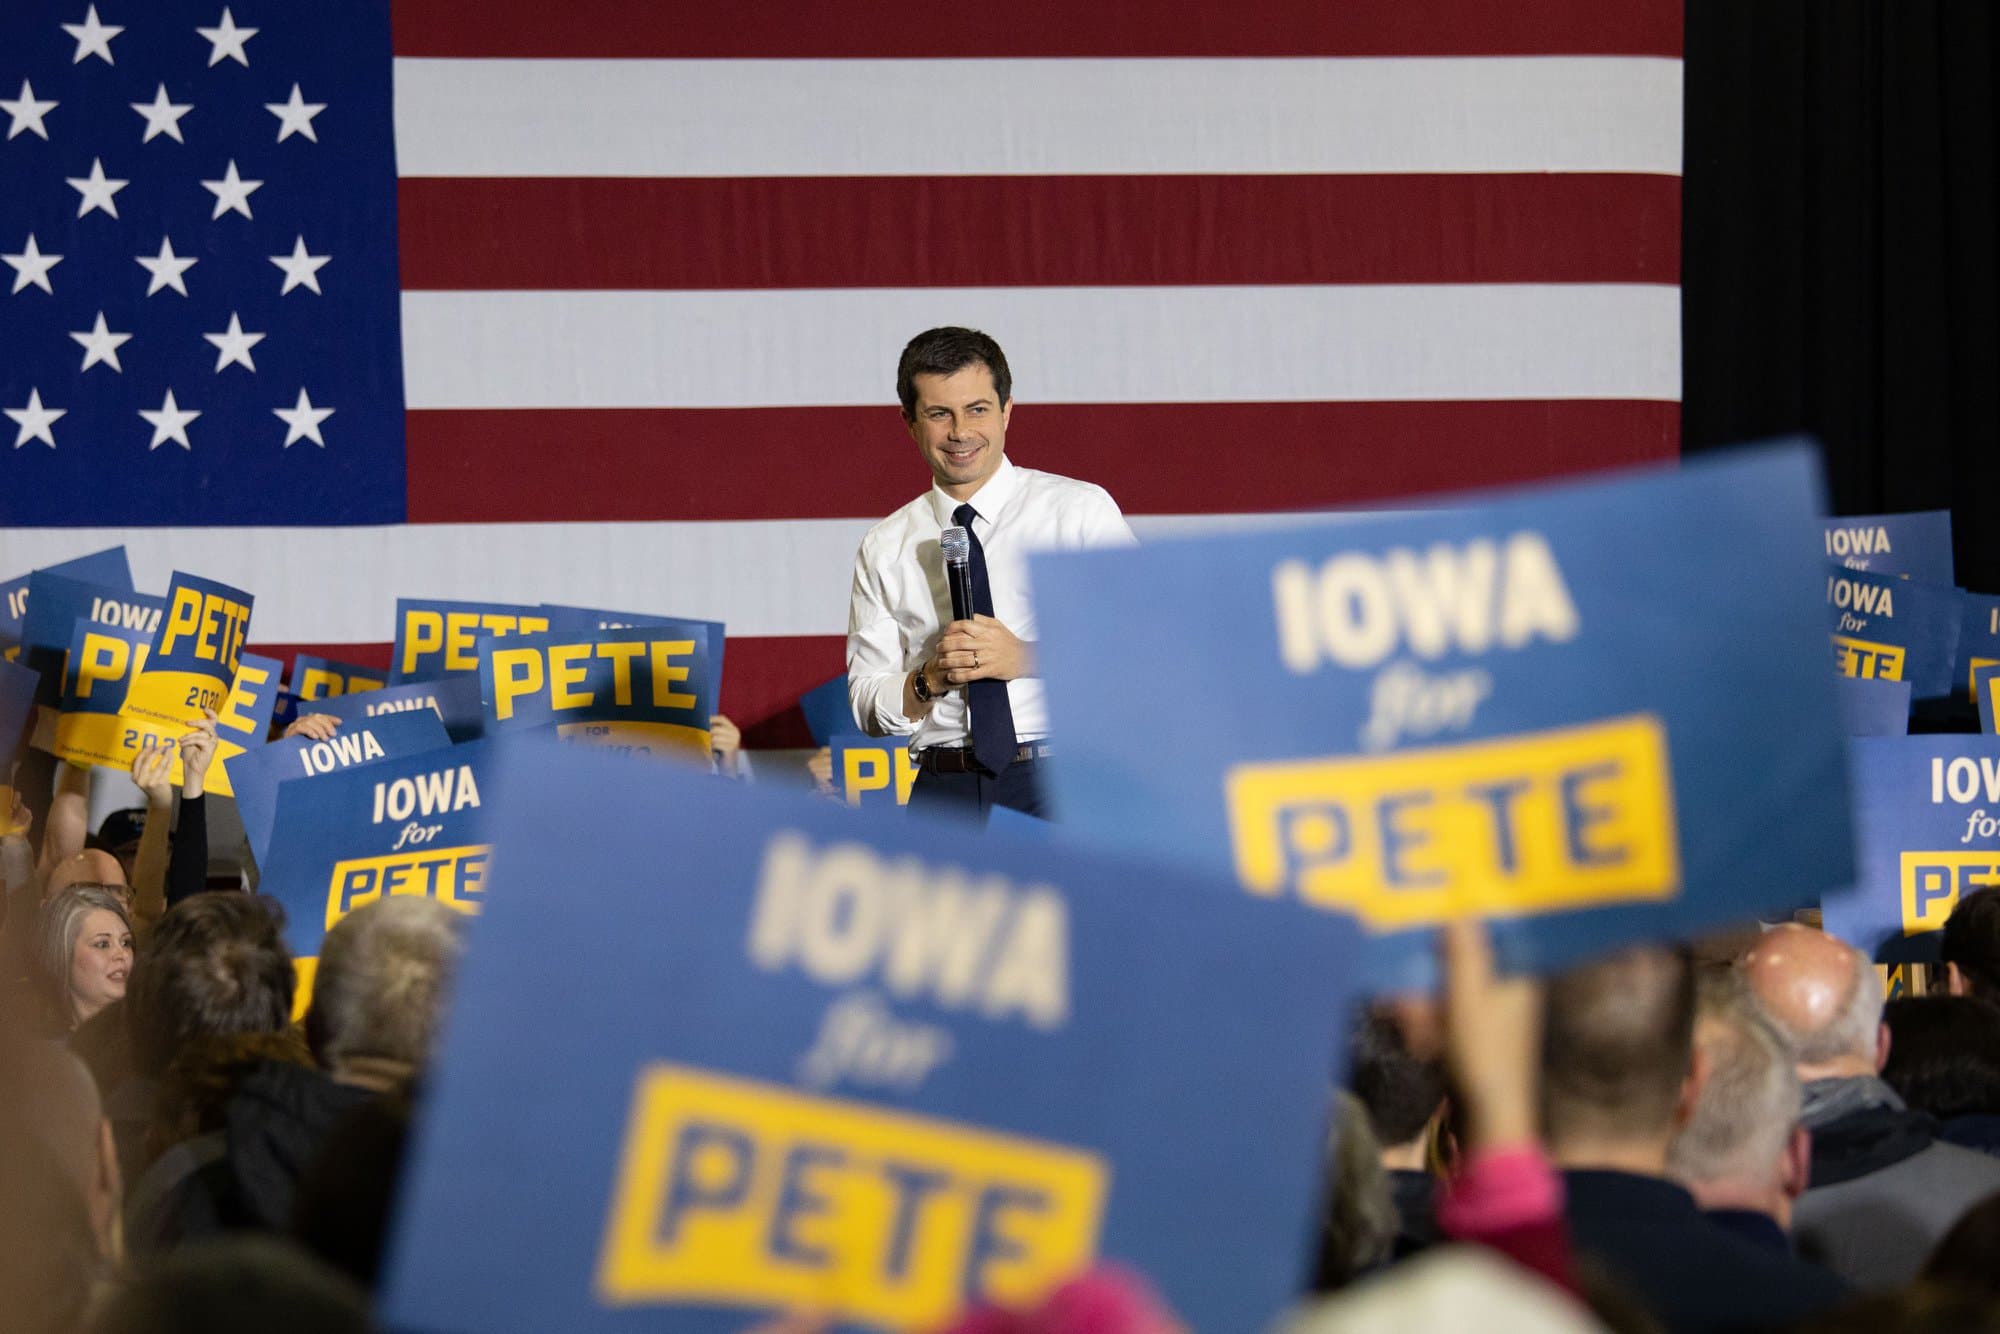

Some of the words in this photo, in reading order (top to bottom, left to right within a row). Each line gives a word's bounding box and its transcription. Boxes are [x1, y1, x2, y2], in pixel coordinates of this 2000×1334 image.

[1825, 526, 1891, 556] IOWA
[159, 586, 249, 674] PETE
[1272, 530, 1580, 674] IOWA
[1827, 576, 1894, 618] IOWA
[1837, 611, 1867, 632] for
[492, 640, 697, 721] PETE
[1358, 660, 1492, 754] for
[300, 730, 385, 776] IOWA
[373, 765, 481, 824] IOWA
[1275, 762, 1636, 892] PETE
[392, 822, 442, 850] for
[748, 828, 1070, 1031] IOWA
